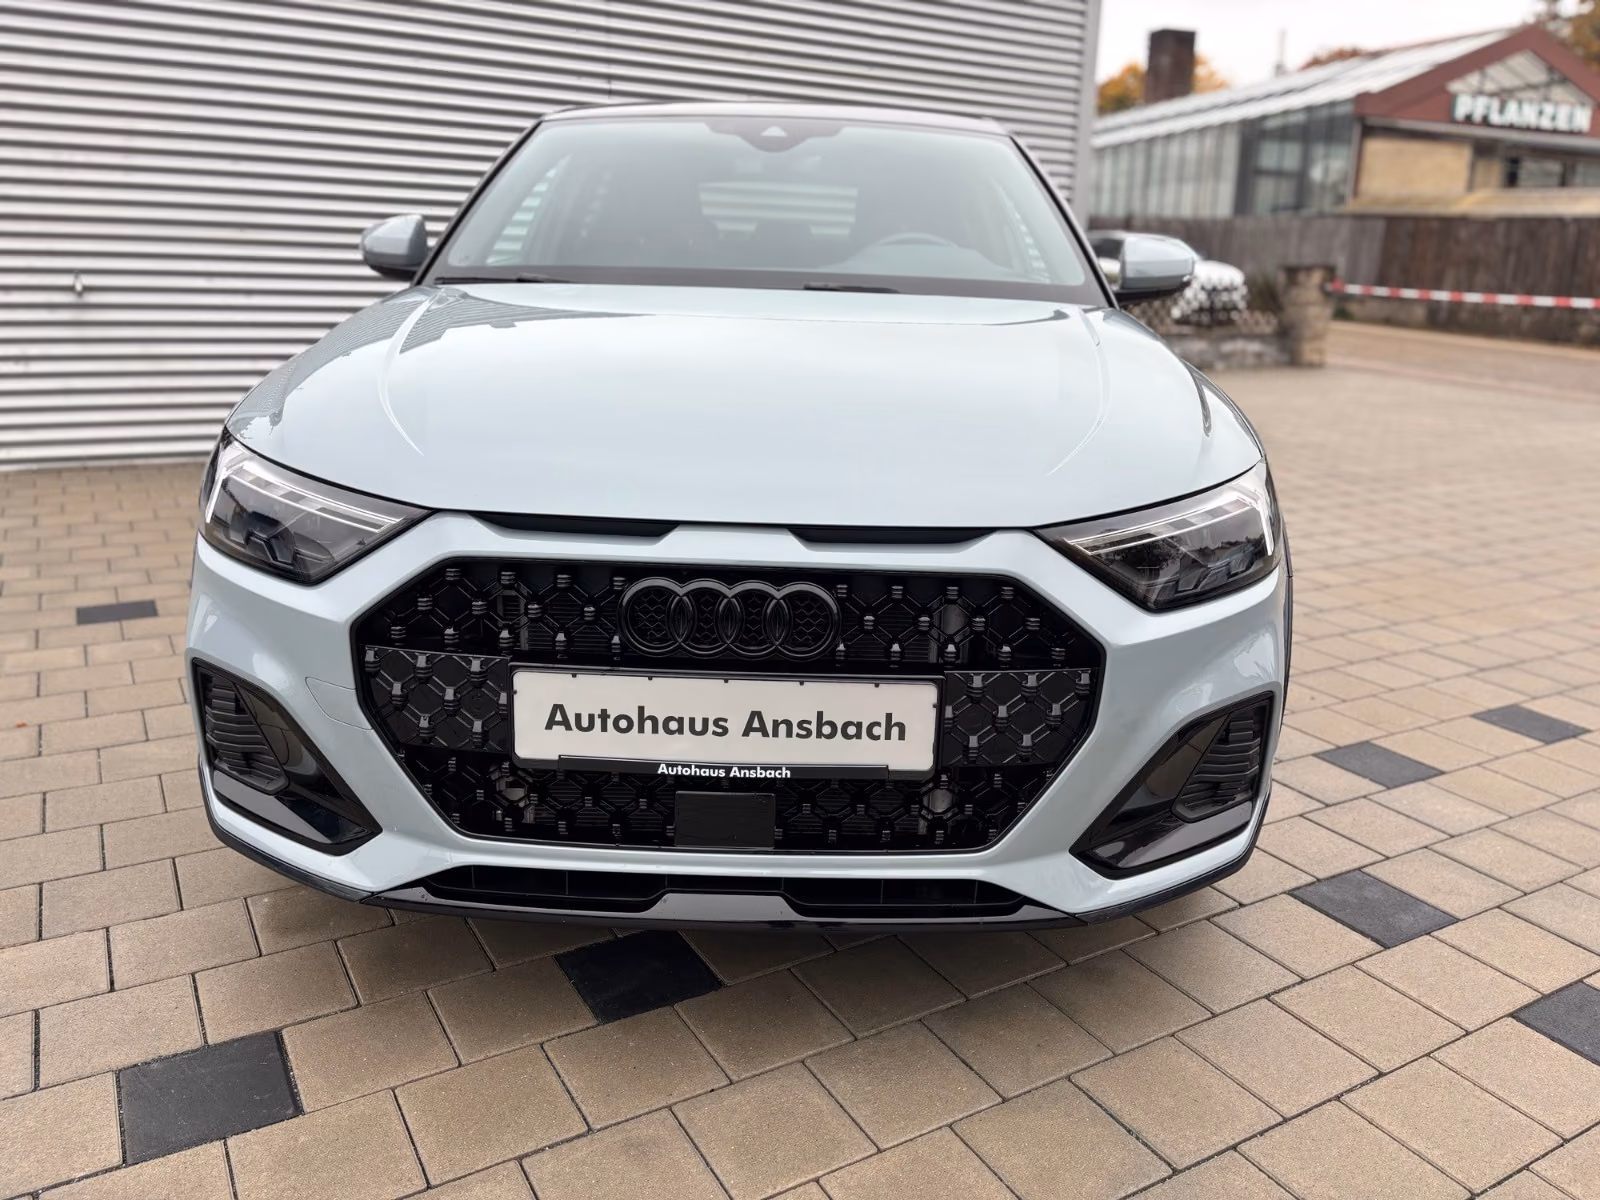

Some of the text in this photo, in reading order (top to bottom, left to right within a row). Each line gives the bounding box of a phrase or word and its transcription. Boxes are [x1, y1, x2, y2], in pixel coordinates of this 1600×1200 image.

[1454, 93, 1592, 132] PFLANZEN
[544, 703, 907, 741] Autohaus Ansbach
[657, 763, 791, 779] Autohaus Ansbach
